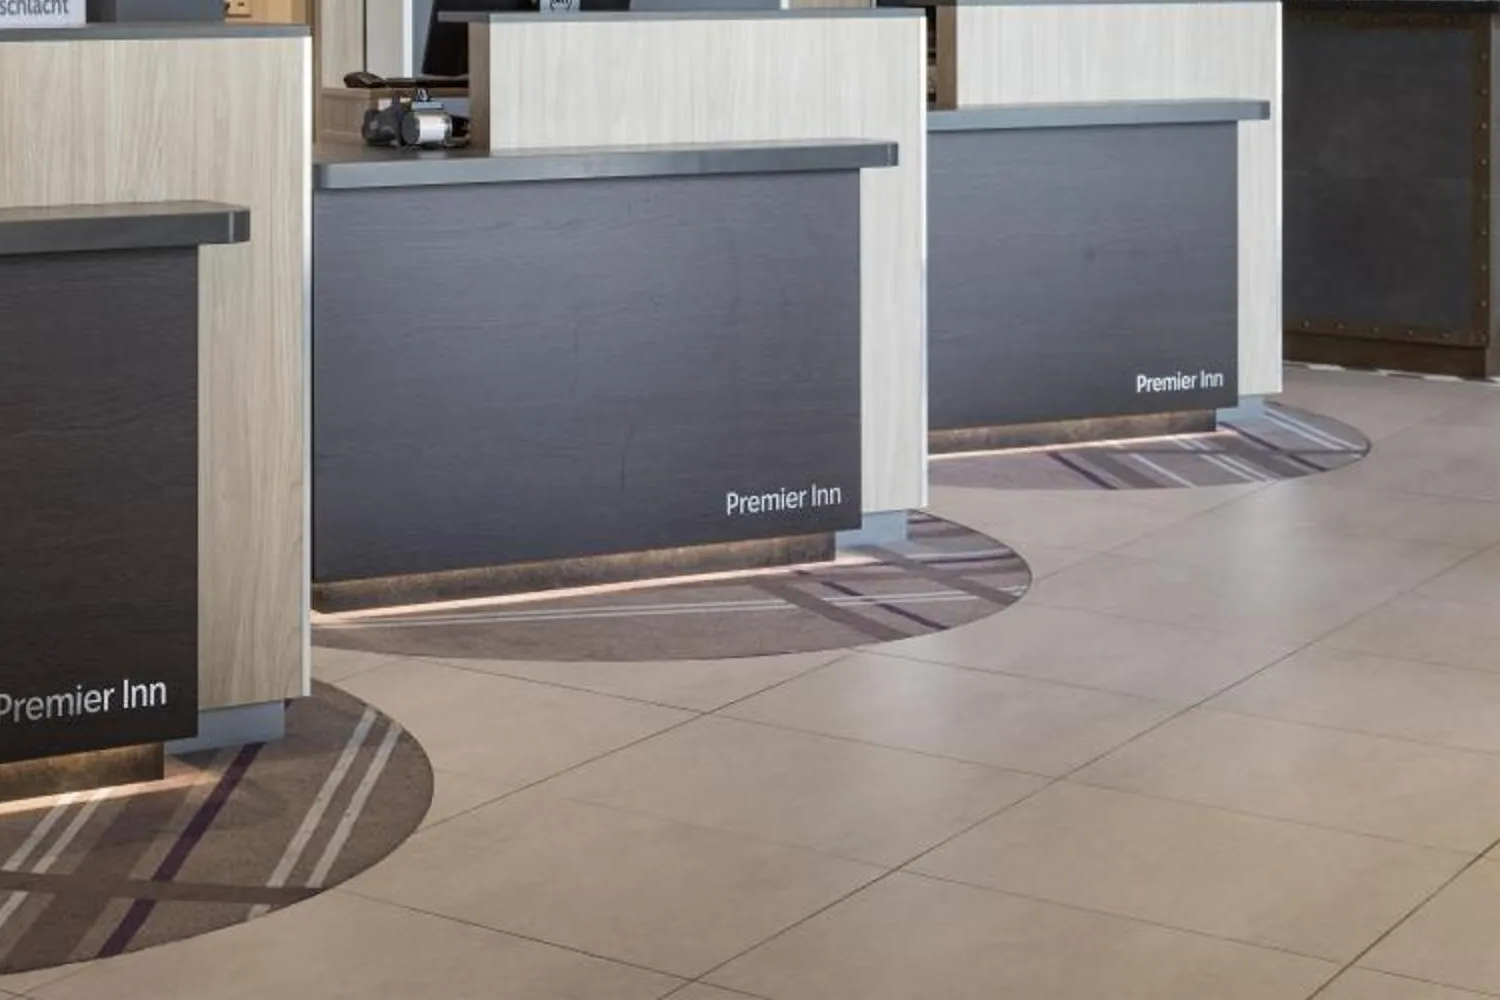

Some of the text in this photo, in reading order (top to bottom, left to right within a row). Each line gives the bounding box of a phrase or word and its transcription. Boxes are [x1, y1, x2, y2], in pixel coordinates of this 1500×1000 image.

[1136, 369, 1224, 393] Premier Inn
[726, 483, 841, 516] Premier Inn
[122, 678, 167, 709] Inn
